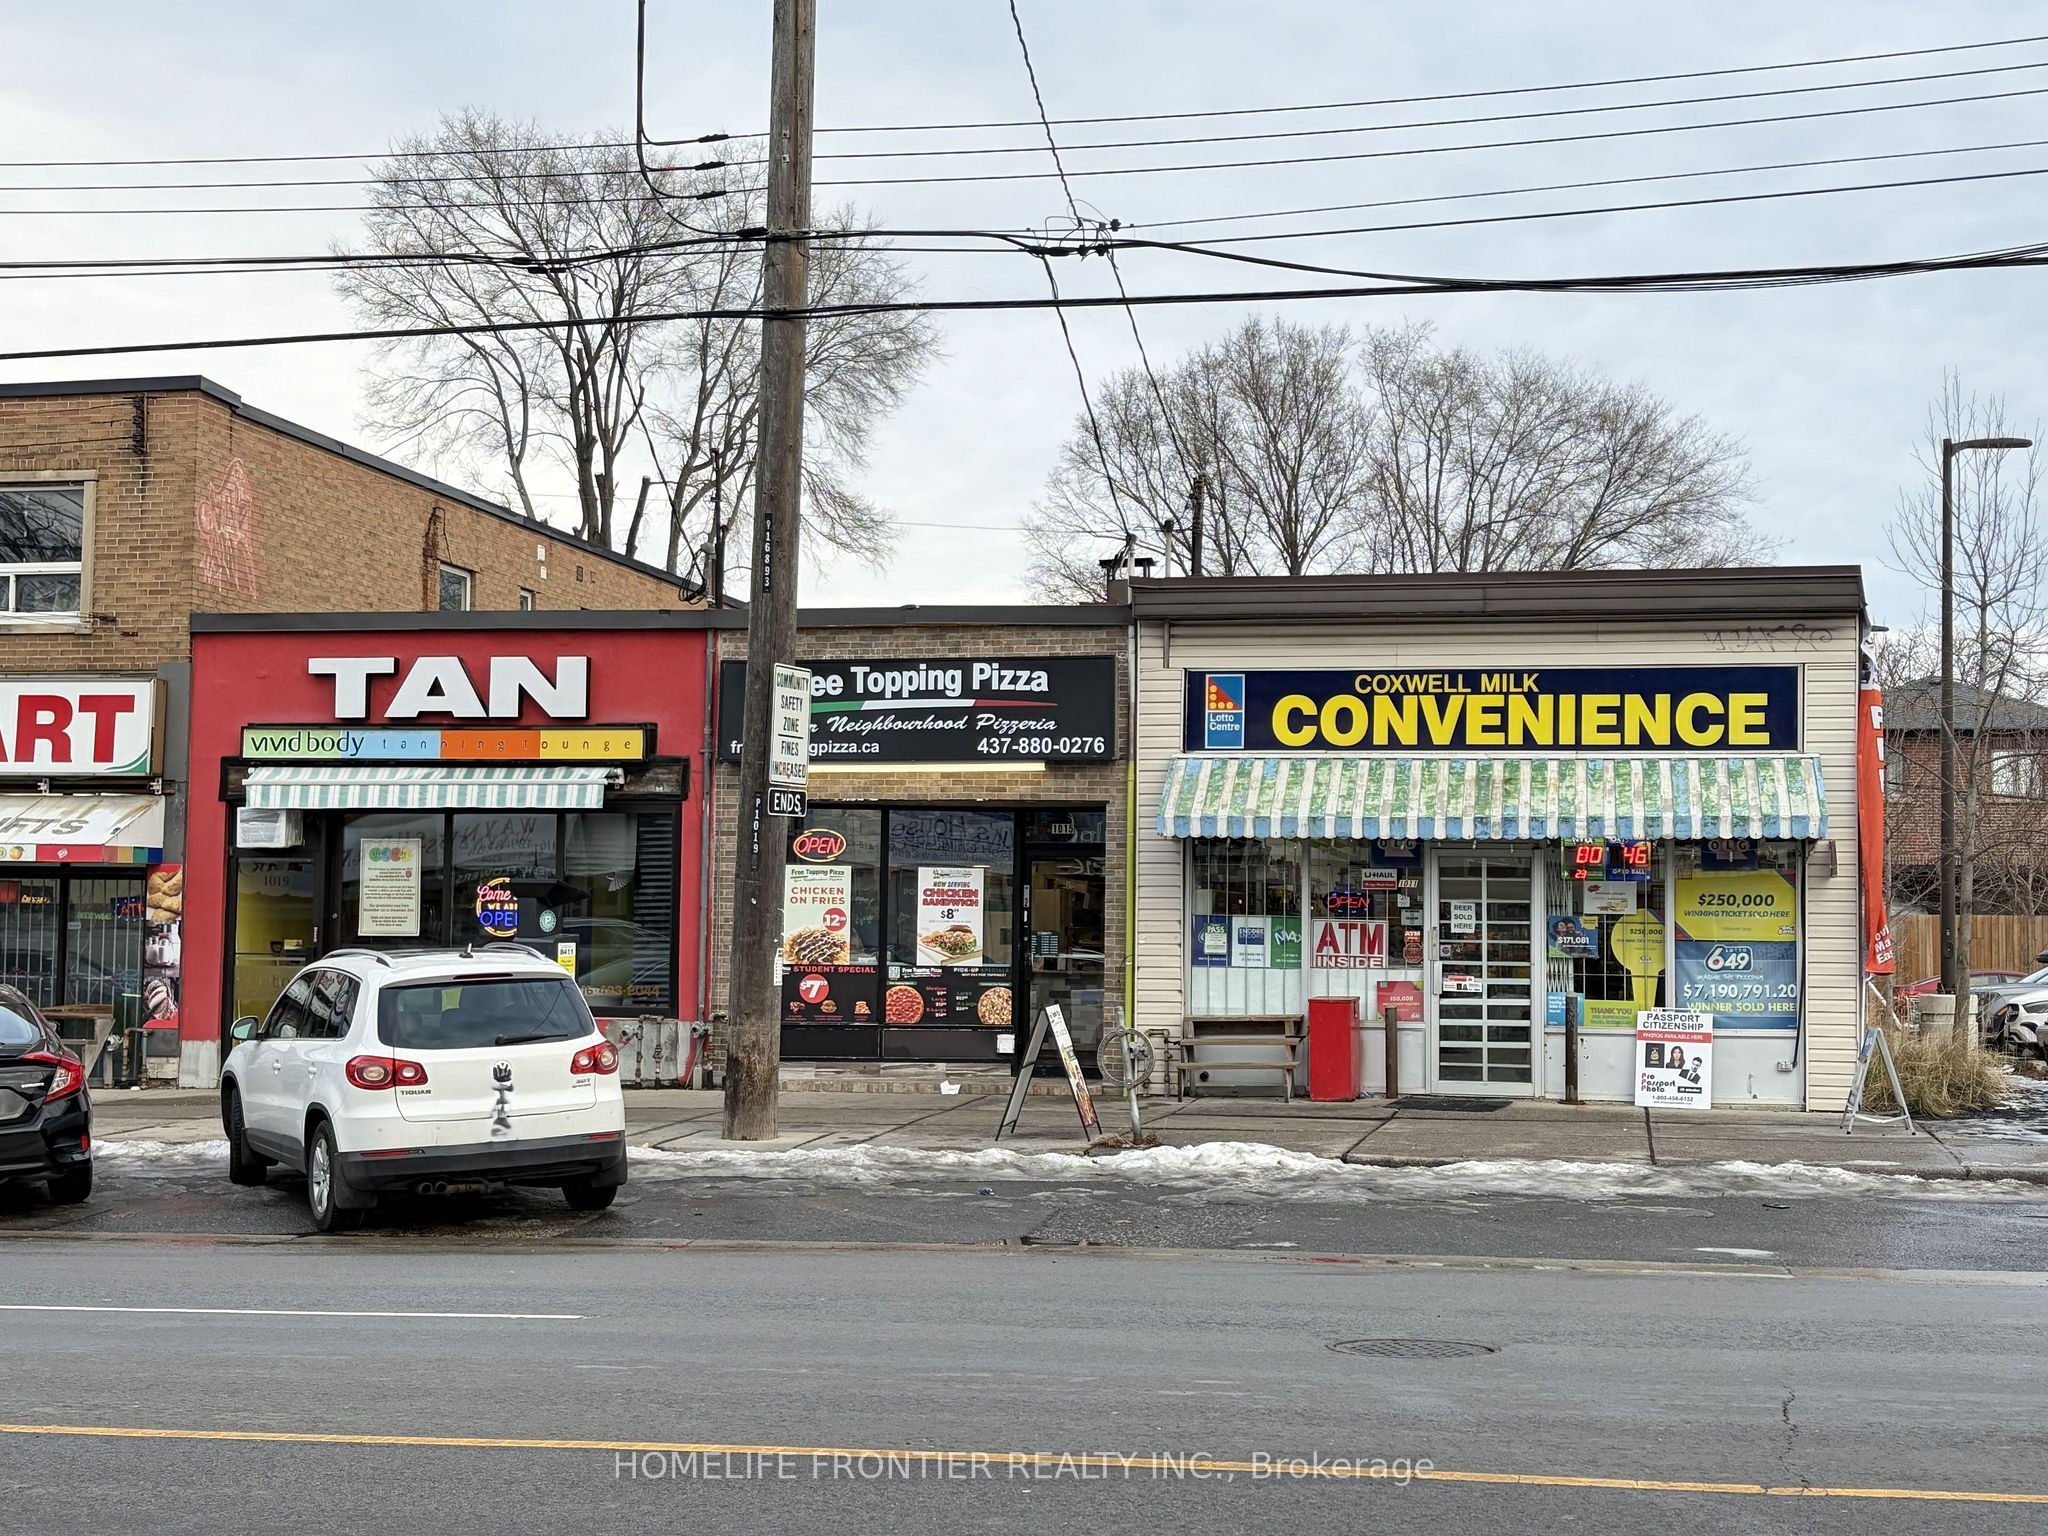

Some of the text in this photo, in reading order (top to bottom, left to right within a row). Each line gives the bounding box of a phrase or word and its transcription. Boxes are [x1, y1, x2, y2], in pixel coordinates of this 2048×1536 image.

[776, 672, 809, 692] COMMUNITY
[811, 662, 1049, 699] ee Topping Pizza
[1354, 672, 1540, 693] COXWELL MILK
[307, 656, 588, 719] TAN
[780, 694, 803, 712] SAFETY
[1209, 713, 1235, 722] Lotto
[1271, 691, 1771, 747] CONVENIENCE
[0, 695, 135, 763] RT
[782, 716, 800, 733] ZONE
[826, 714, 969, 736] Neighbourhood
[975, 713, 1058, 735] Pizzeria
[1209, 722, 1240, 731] Centre
[250, 730, 632, 757] vivid body tanning lounge
[780, 740, 799, 757] FINES
[976, 736, 1105, 754] 437-880-0276
[771, 762, 806, 779] INCREASED
[773, 792, 801, 812] ENDS
[797, 837, 842, 854] OPEN
[1575, 846, 1604, 864] 80
[1623, 846, 1647, 864] 46
[791, 868, 805, 876] Free
[1574, 869, 1588, 879] 23
[264, 875, 290, 888] 1019
[477, 885, 512, 902] Come
[791, 886, 844, 895] CHICKEN
[922, 888, 979, 898] CHICKEN
[487, 902, 501, 911] WE
[790, 896, 846, 905] ON FRIES
[922, 898, 979, 907] SANDWICH
[1328, 895, 1372, 909] OPEN
[1697, 893, 1775, 908] $250,000
[1453, 913, 1473, 921] SOLD
[1684, 910, 1720, 918] WINNING
[1720, 910, 1749, 918] TICKET
[1749, 910, 1769, 918] SOLD
[1207, 925, 1225, 933] PASS
[1453, 922, 1473, 930] HERE
[1316, 922, 1384, 954] ATM
[1557, 936, 1590, 944] $171,081
[1315, 956, 1384, 969] INSIDE
[793, 965, 877, 974] STUDENT SPECIAL
[1683, 981, 1797, 1000] $7,190,791.20
[1590, 1007, 1632, 1015] THANK YOU
[1686, 1002, 1796, 1012] WINNER SOLD HERE
[1646, 1013, 1701, 1023] PASSPORT
[1642, 1021, 1704, 1031] CITIZENSHIP
[1641, 1072, 1655, 1080] Pro
[1641, 1079, 1676, 1088] Passport
[1641, 1085, 1665, 1093] Photo
